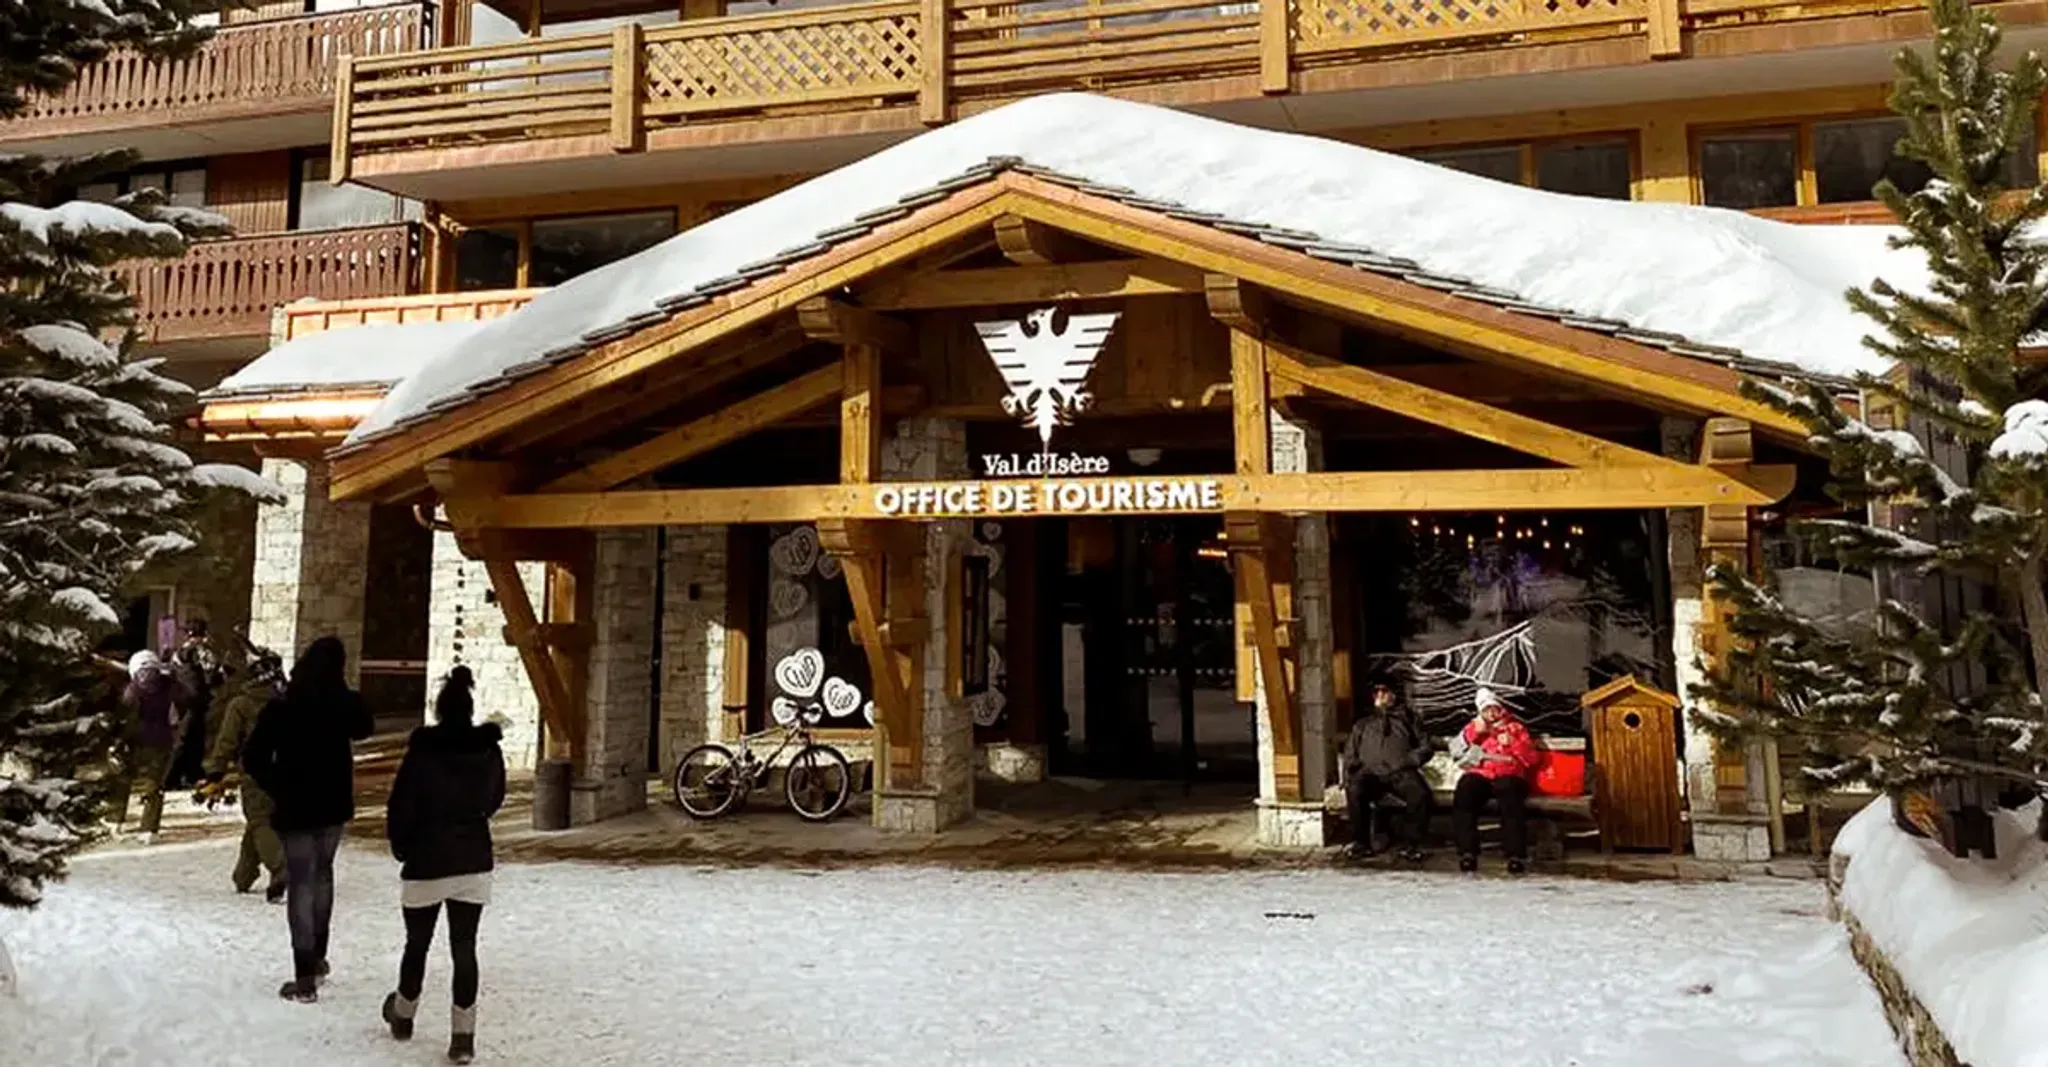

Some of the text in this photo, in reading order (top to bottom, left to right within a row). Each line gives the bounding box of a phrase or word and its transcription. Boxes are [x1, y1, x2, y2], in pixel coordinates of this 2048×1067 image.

[982, 452, 1110, 475] Val d'Isère
[875, 480, 1218, 514] OFFICE DE TOURISME
